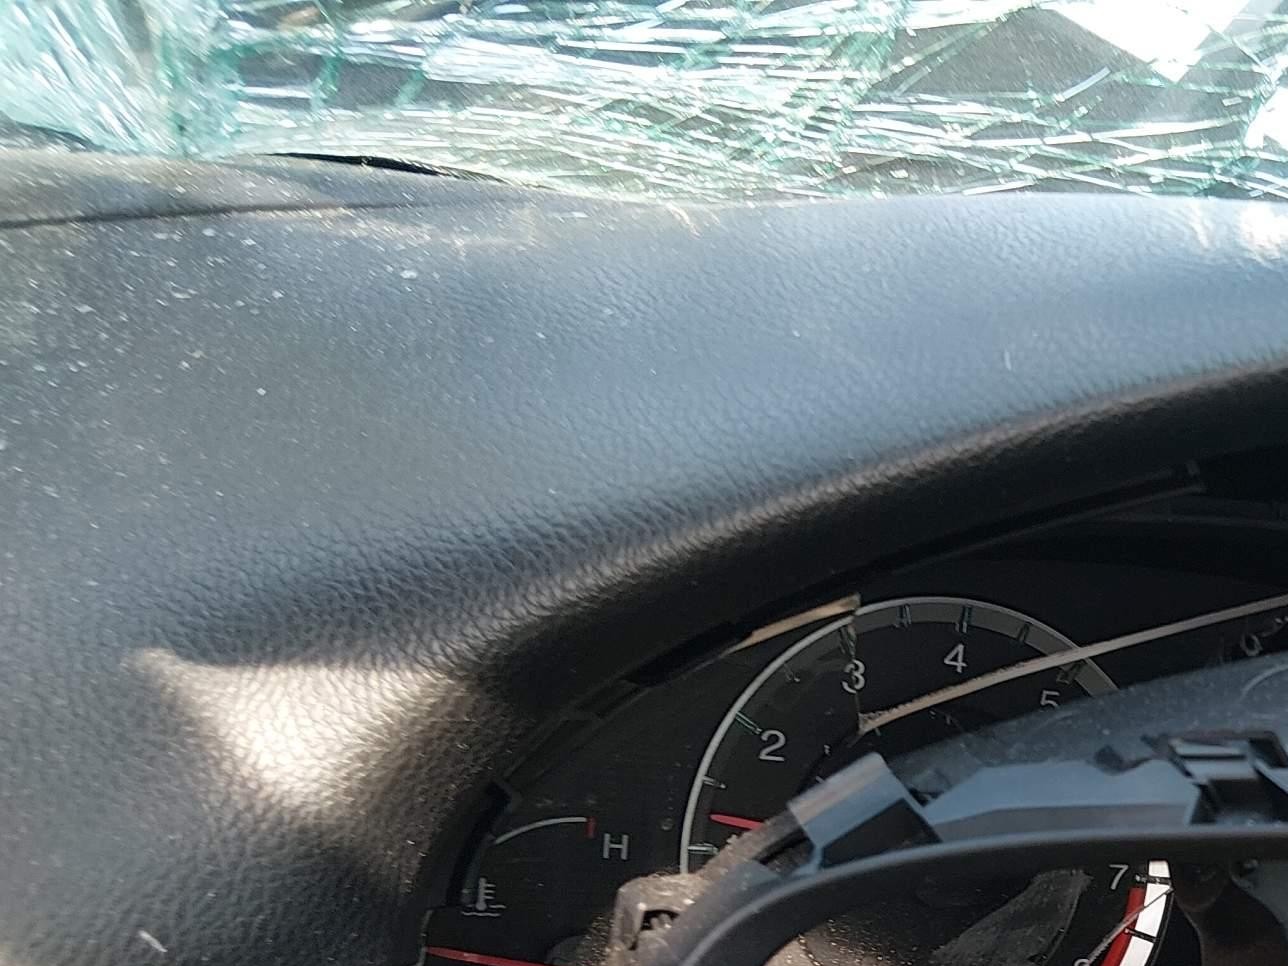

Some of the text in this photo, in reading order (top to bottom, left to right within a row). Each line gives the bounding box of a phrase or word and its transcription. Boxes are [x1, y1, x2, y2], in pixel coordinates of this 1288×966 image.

[943, 643, 968, 674] 4
[841, 660, 867, 694] 3
[1039, 689, 1061, 710] 5
[758, 728, 787, 763] 2
[602, 832, 630, 861] H
[1108, 864, 1129, 891] 7
